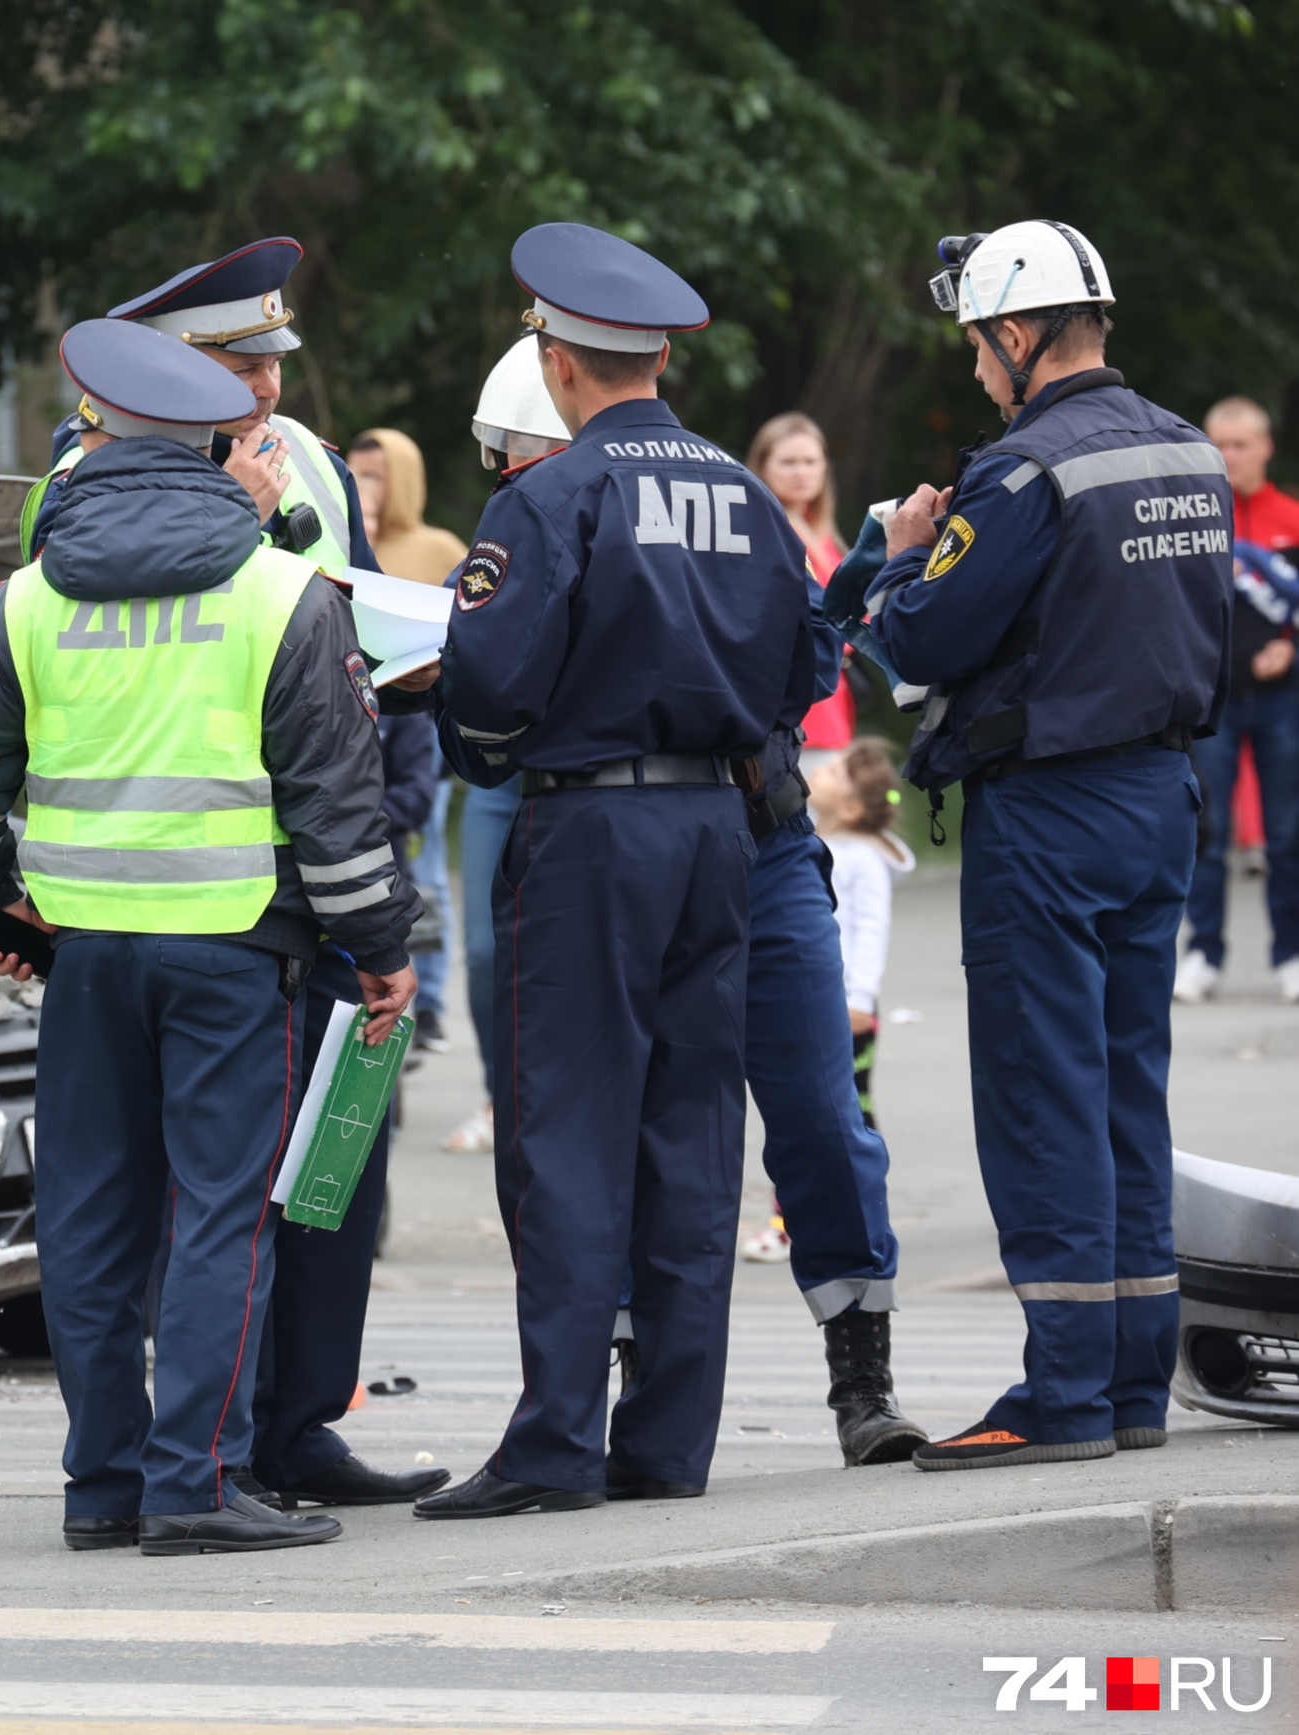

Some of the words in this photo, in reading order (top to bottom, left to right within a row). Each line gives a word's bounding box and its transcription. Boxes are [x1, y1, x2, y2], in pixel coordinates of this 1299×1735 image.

[603, 441, 737, 465] ПОЛИЦИЯ
[634, 476, 751, 555] ДПС
[1134, 493, 1222, 523] СЛУЖБА
[476, 542, 508, 560] ПОЛИЦИЯ
[1121, 529, 1229, 563] СПАСЕНИЯ
[469, 557, 500, 577] РОССИЯ
[57, 579, 234, 650] ДПС
